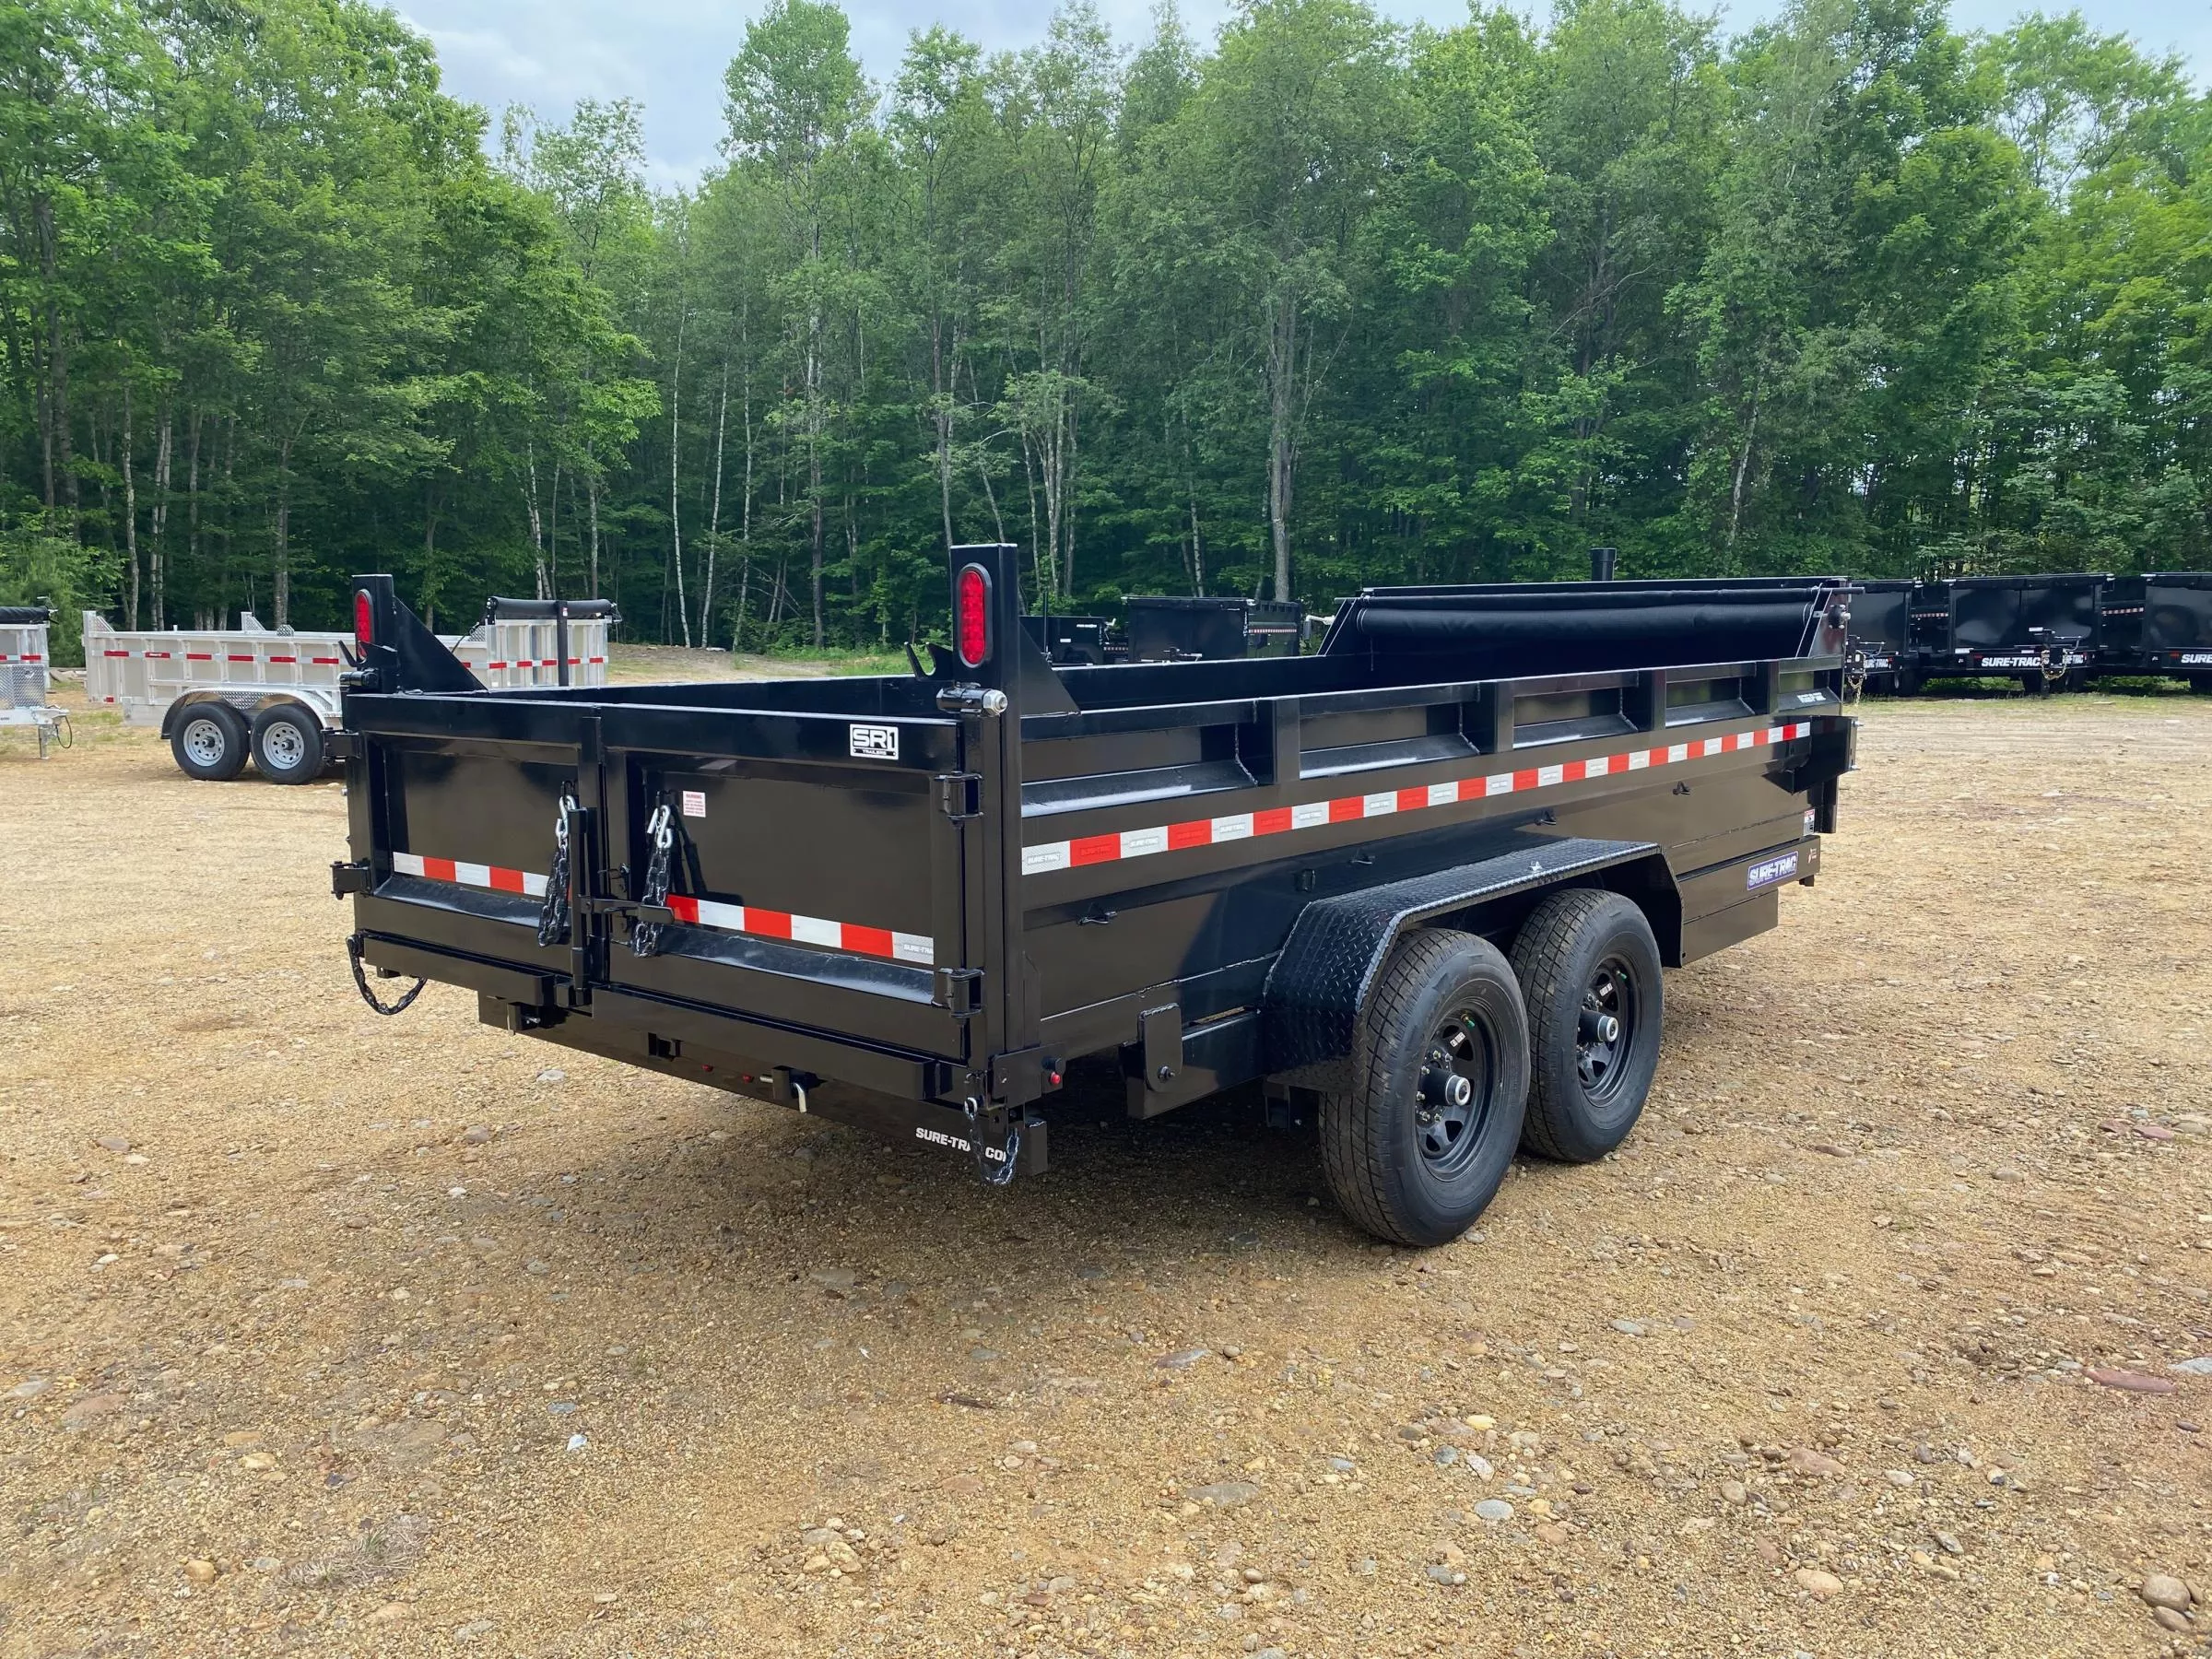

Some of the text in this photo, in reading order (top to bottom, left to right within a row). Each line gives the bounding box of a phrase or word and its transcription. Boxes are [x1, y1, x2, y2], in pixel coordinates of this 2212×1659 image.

[1982, 656, 2041, 666] SURE-TRAC
[853, 727, 895, 749] SR1
[1749, 855, 1797, 886] SURE-TRAC
